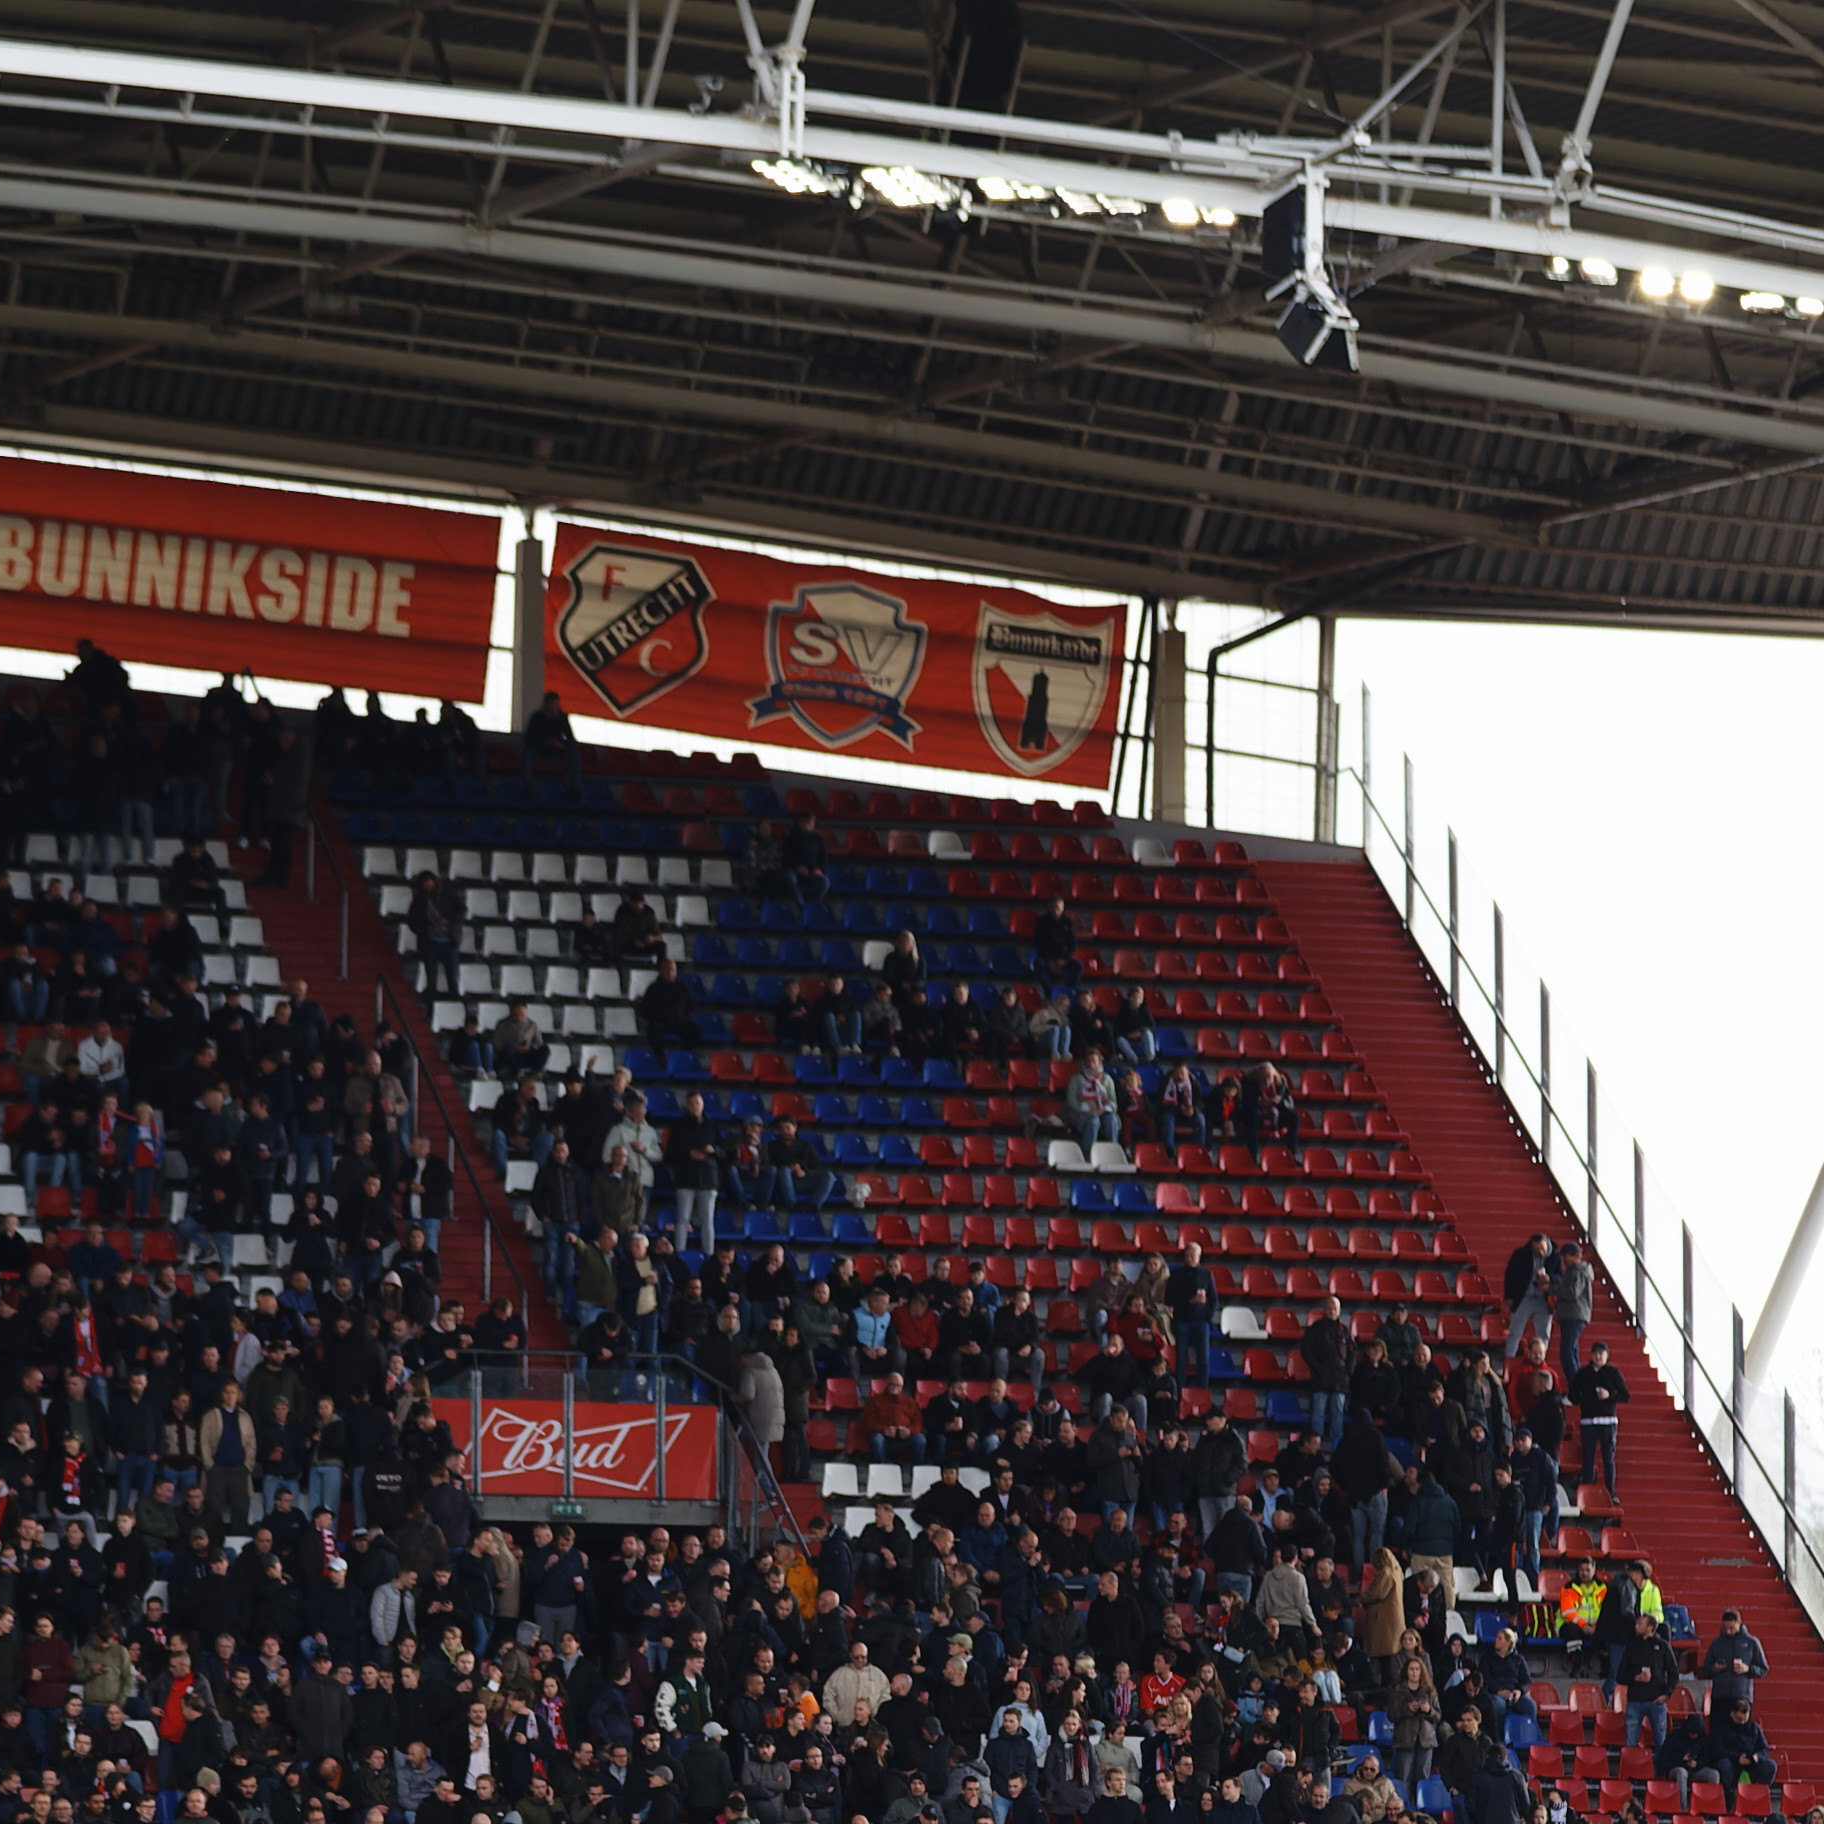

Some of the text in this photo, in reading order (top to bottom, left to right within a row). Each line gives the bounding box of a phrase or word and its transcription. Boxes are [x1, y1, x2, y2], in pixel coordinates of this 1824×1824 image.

[601, 564, 628, 602] F
[576, 570, 697, 671] UTRECHT
[639, 638, 674, 678] C
[788, 621, 905, 678] SV
[493, 1419, 630, 1471] Bud
